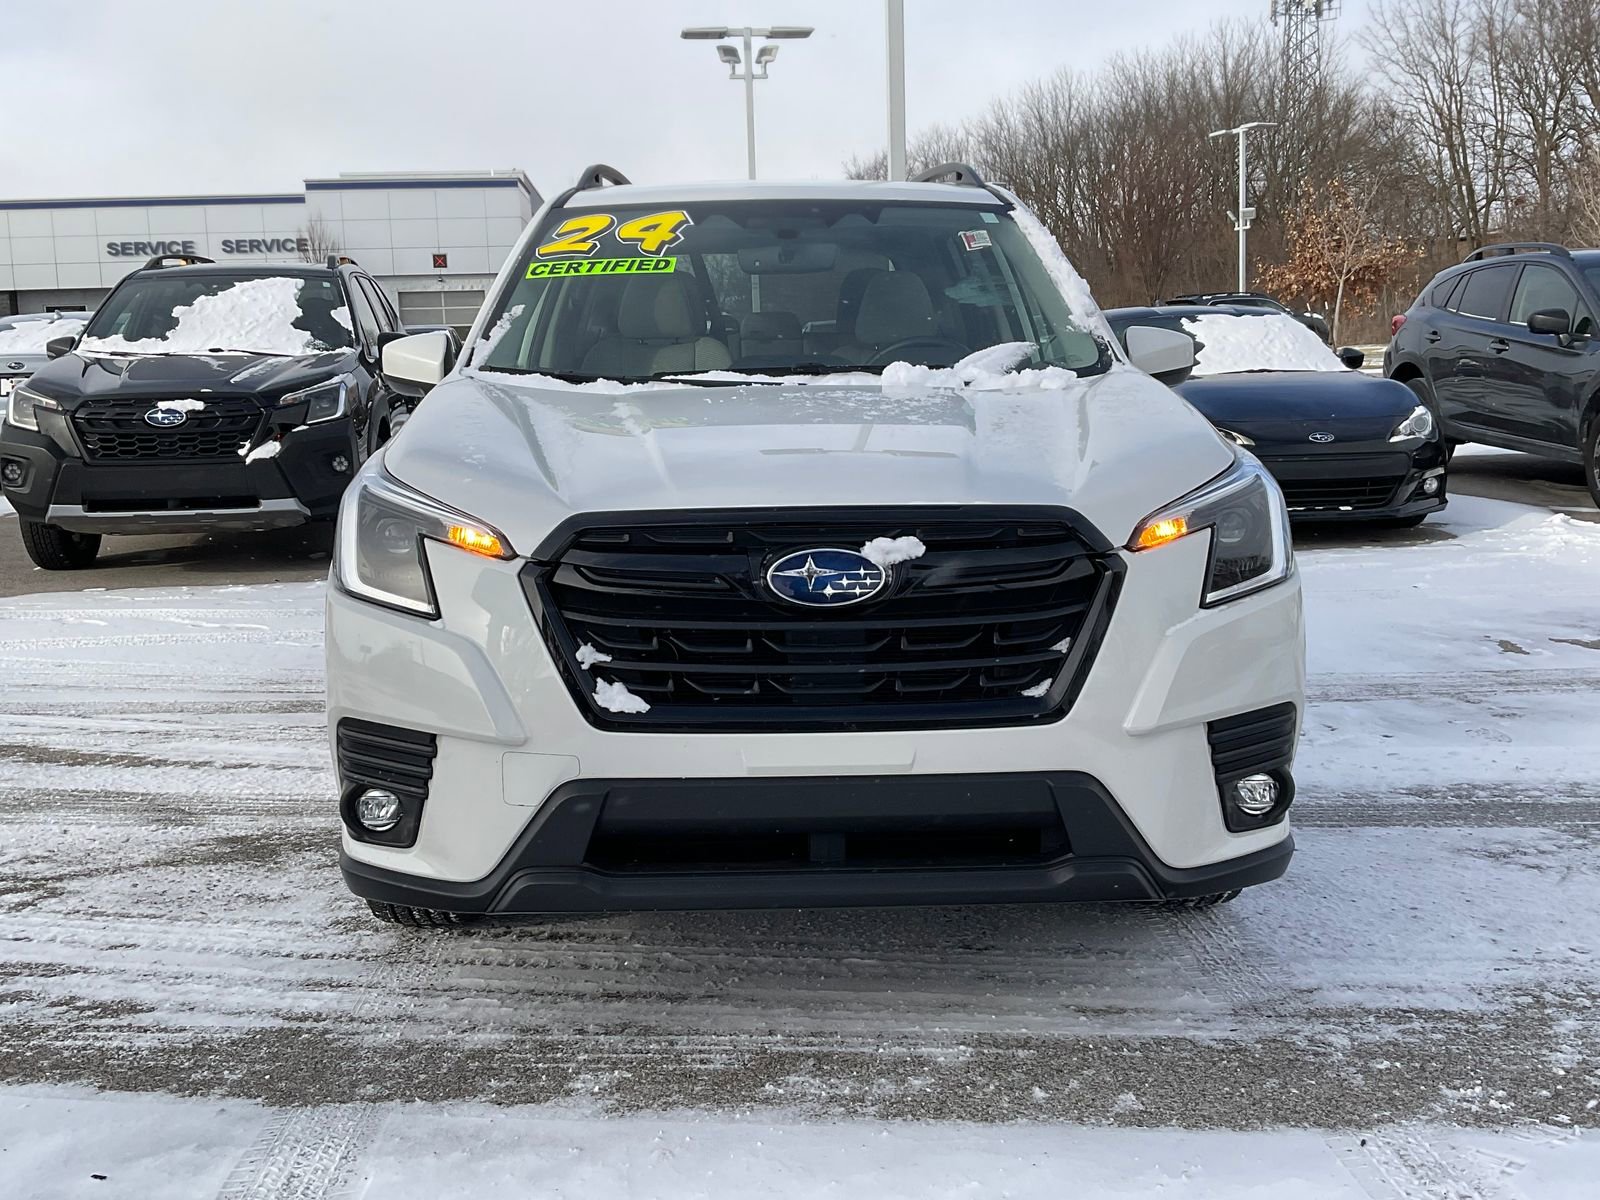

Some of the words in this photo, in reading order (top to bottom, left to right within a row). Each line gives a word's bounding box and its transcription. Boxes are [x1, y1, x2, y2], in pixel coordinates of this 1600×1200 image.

[536, 210, 694, 259] 24
[107, 240, 195, 256] SERVICE
[221, 238, 309, 254] SERVICE
[530, 258, 672, 276] CERTIFIED
